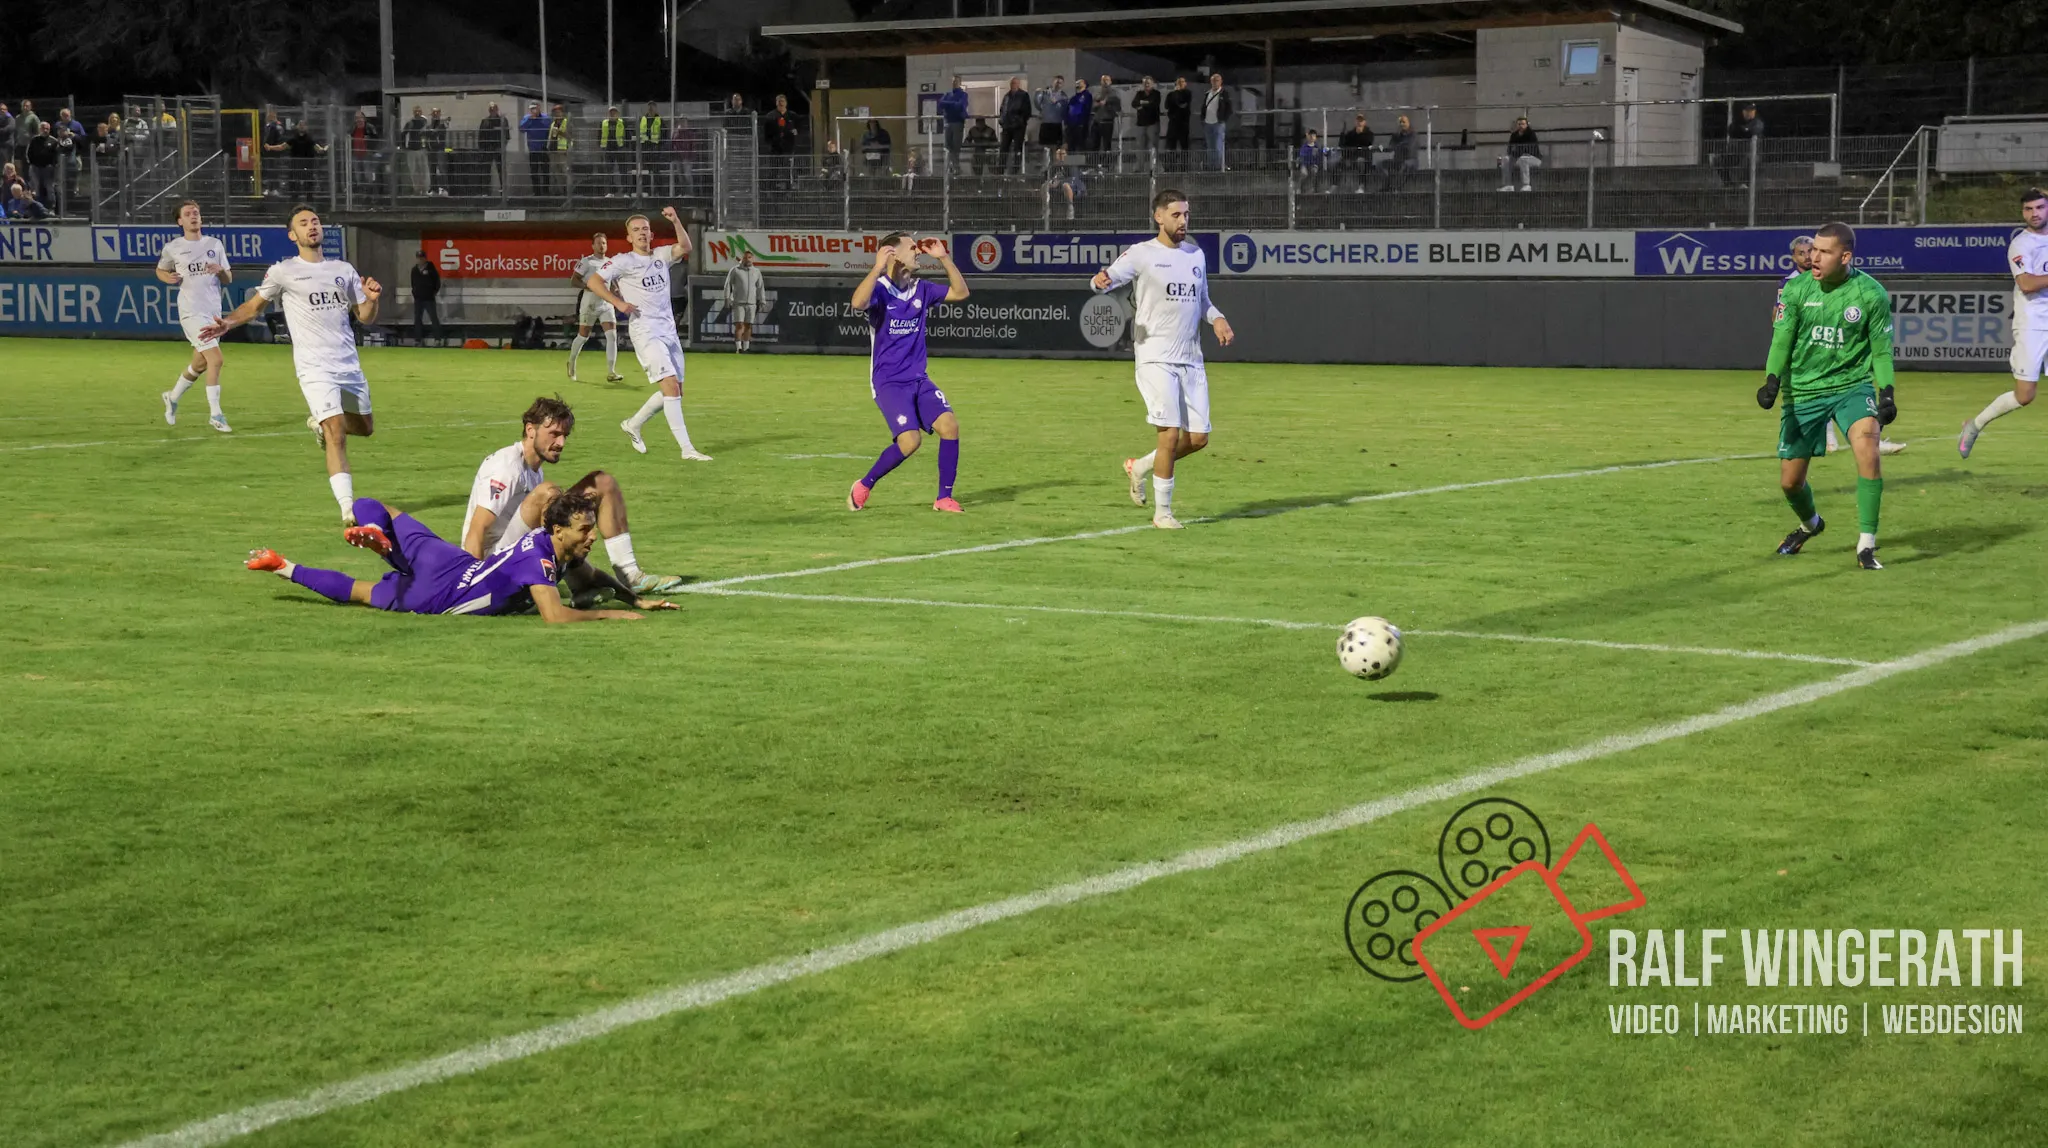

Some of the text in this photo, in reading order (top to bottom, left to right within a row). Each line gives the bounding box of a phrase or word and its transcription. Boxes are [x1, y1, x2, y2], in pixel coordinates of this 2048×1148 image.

[1914, 236, 2006, 248] SIGNAL IDUNA
[1013, 235, 1132, 267] Ensing
[1262, 243, 1629, 263] MESCHER.DE BLEIB AM BALL.
[465, 254, 585, 273] Sparkasse Pforz
[1867, 256, 1903, 266] TEAM
[642, 274, 665, 288] GEA
[1166, 282, 1197, 297] GEA
[0, 283, 102, 323] EINER
[114, 285, 236, 325] AREA
[309, 291, 342, 306] GEA
[788, 301, 838, 317] Zündel
[939, 304, 963, 319] Die
[967, 304, 1071, 320] Steuerkanzlei.
[1093, 305, 1112, 316] WIR
[1083, 316, 1121, 326] SUCHEN
[1090, 326, 1115, 336] DICH!
[1811, 325, 1845, 343] GEA
[1905, 347, 1929, 357] UND
[934, 389, 946, 404] 9
